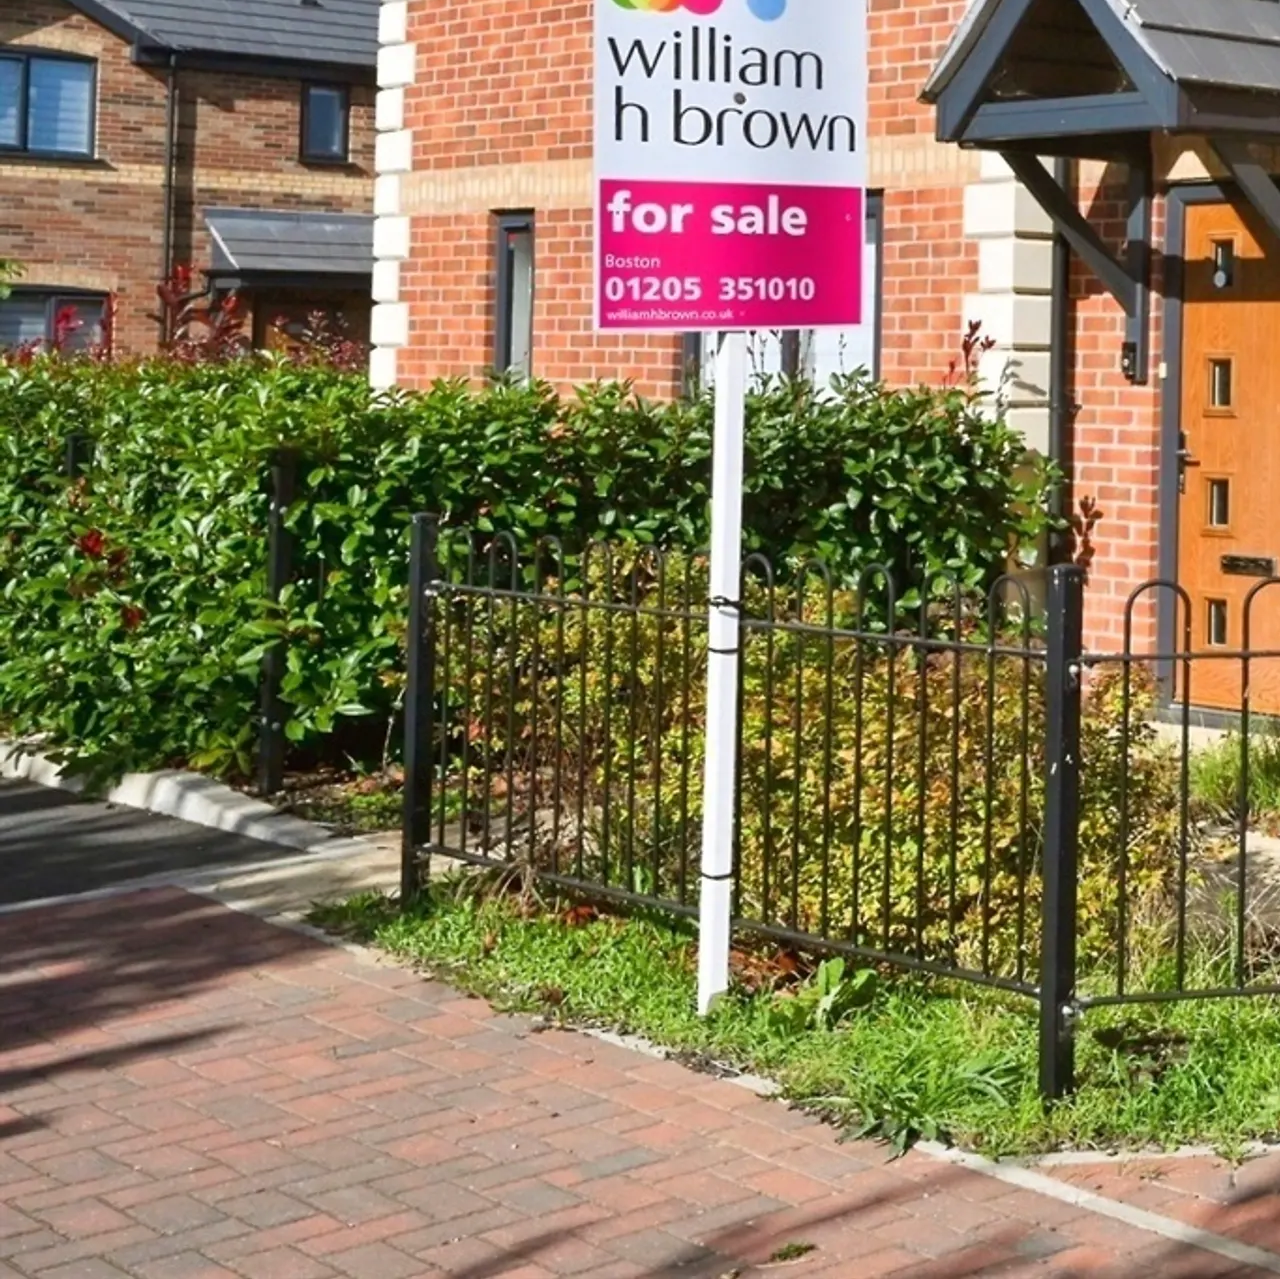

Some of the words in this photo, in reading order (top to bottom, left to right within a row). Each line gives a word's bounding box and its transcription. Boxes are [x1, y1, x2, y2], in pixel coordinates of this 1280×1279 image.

[607, 25, 823, 89] william
[615, 85, 649, 142] h
[673, 88, 856, 152] brown
[606, 189, 694, 233] for
[711, 194, 808, 236] sale
[605, 253, 661, 269] Boston
[605, 276, 701, 301] 01205
[718, 277, 815, 301] 351010
[606, 308, 734, 321] williamhbrown.co.uk
